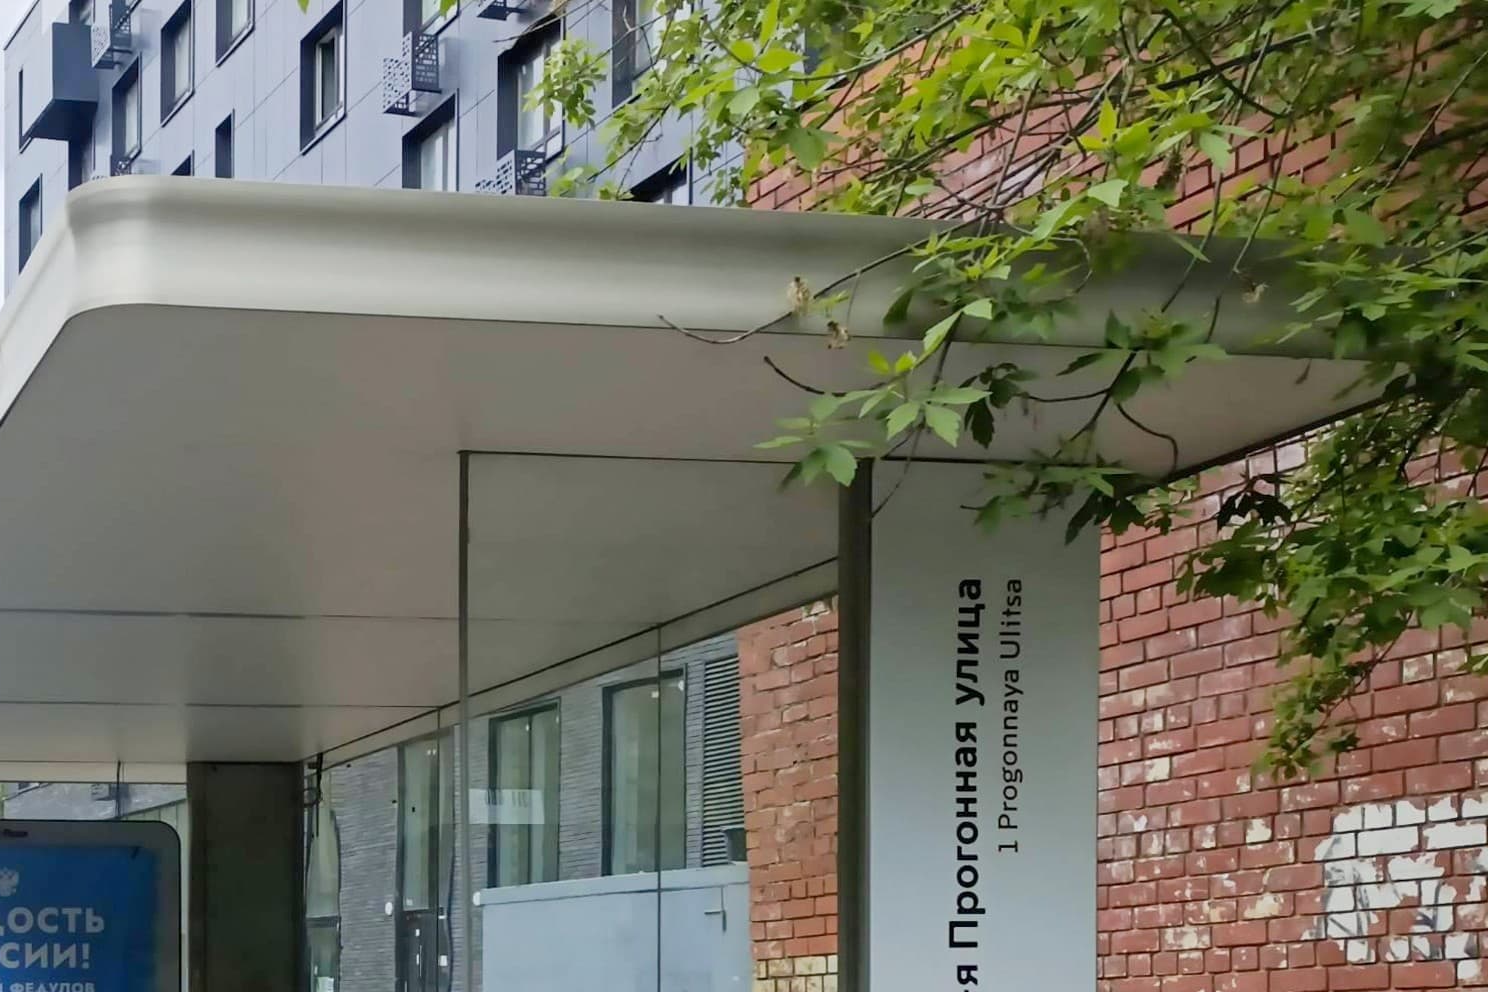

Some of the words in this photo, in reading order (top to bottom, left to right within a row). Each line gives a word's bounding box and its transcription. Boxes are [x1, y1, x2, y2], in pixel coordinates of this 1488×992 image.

[955, 578, 985, 706] улица
[999, 578, 1022, 659] Ulitsa
[997, 669, 1024, 829] Progonnaya
[948, 721, 986, 949] Прогонная
[998, 840, 1019, 853] 1
